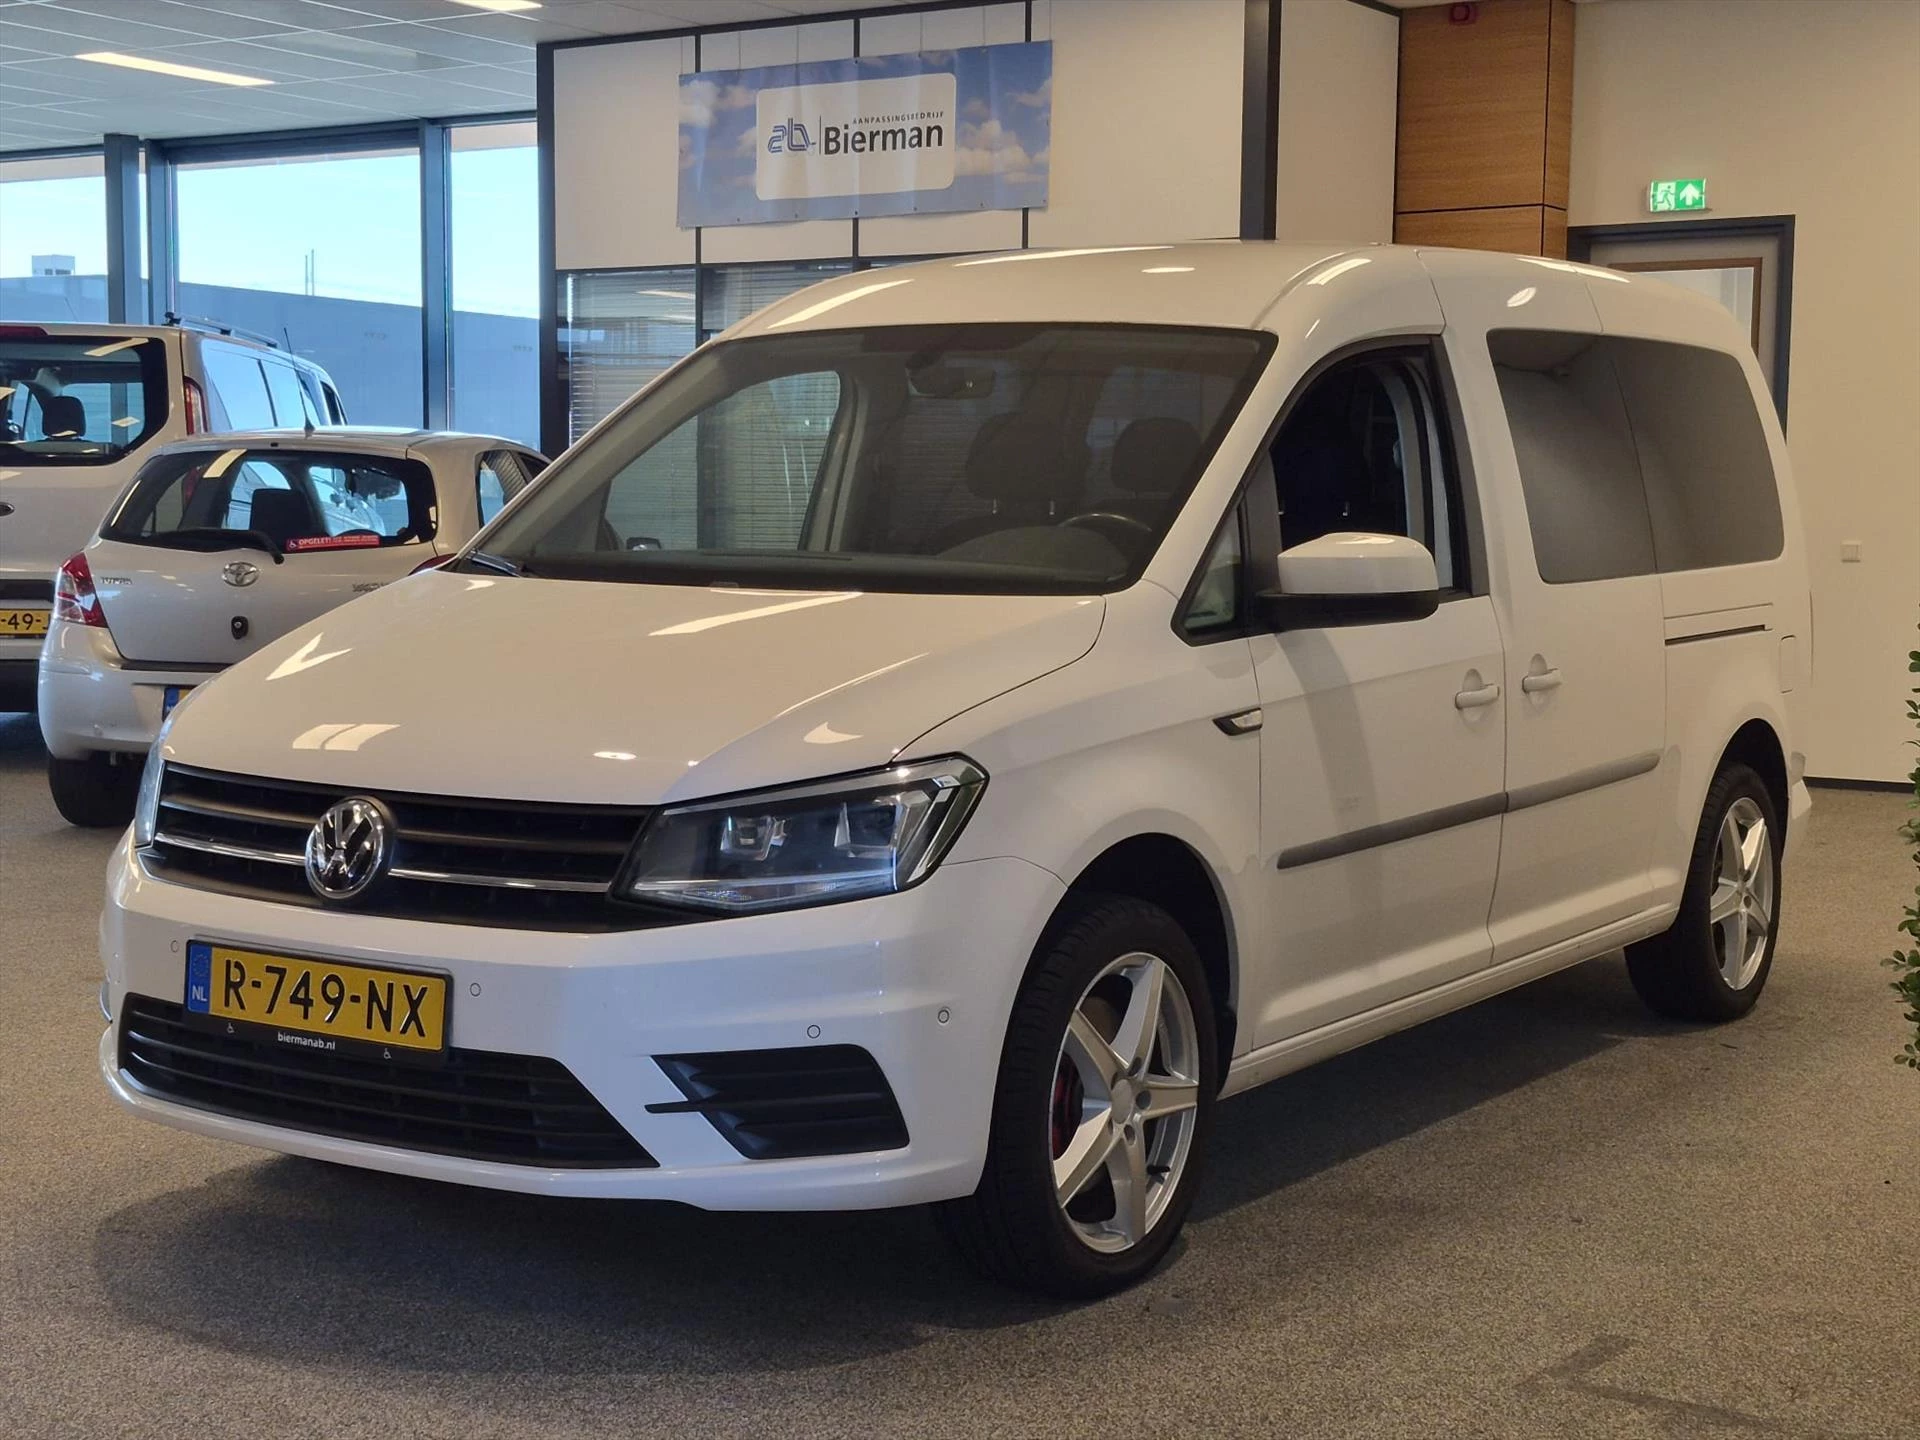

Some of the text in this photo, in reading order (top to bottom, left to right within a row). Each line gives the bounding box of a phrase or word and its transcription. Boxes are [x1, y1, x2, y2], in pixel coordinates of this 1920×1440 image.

[824, 124, 943, 155] Bierman
[191, 985, 208, 1002] NL
[223, 958, 429, 1038] R-749-NX
[277, 1031, 336, 1051] biermanab.nl
